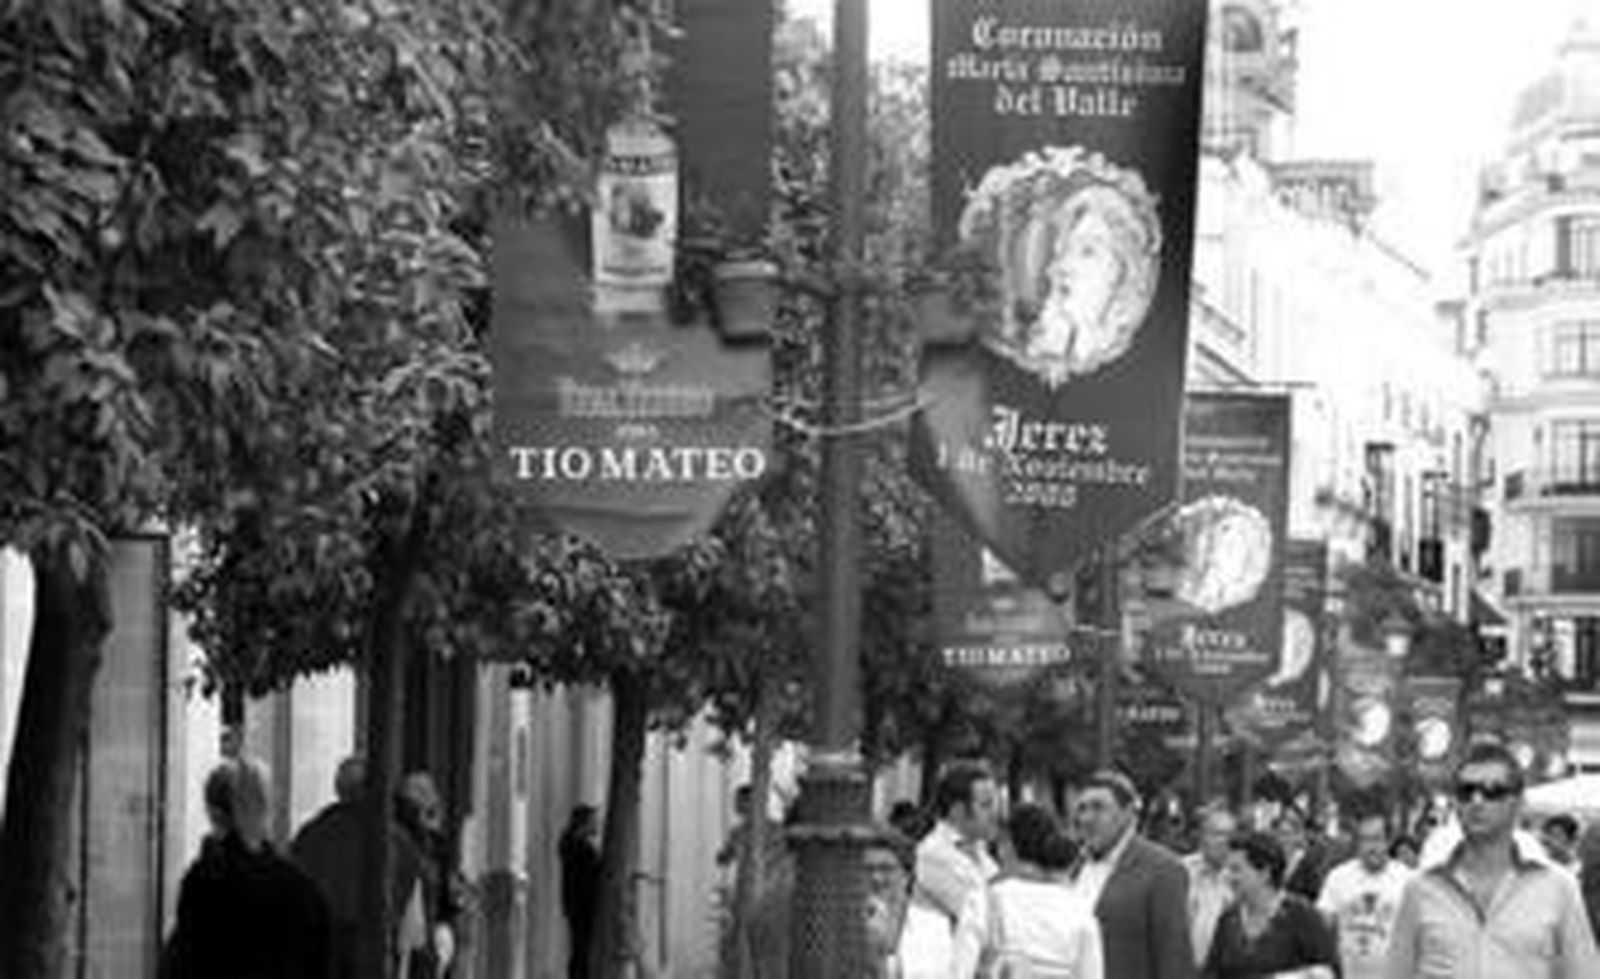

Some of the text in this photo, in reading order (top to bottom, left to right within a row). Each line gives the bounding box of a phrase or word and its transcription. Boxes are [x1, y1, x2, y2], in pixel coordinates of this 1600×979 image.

[995, 85, 1138, 117] del Valle
[983, 404, 1108, 453] Jerez
[510, 447, 766, 480] TIO MATEO
